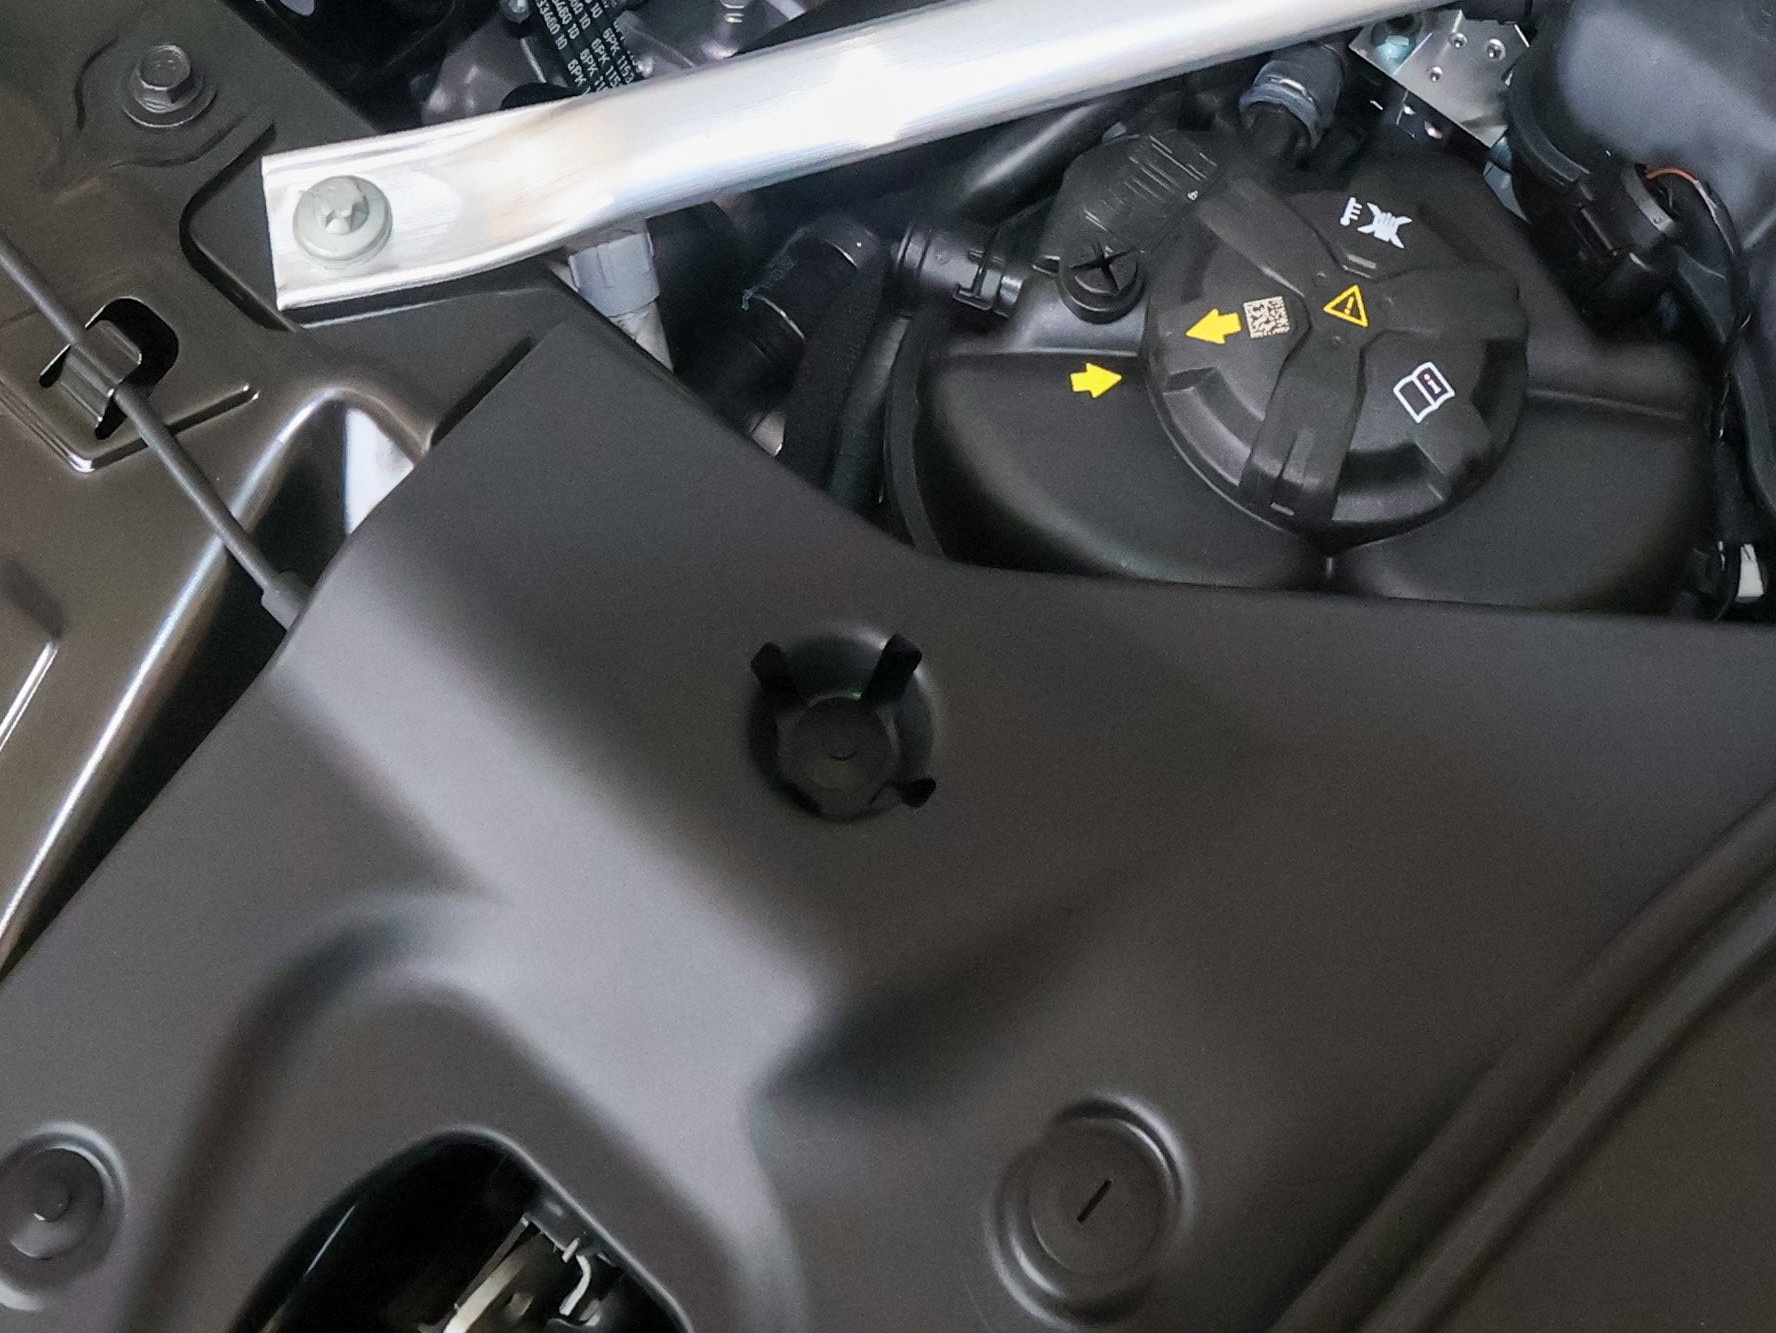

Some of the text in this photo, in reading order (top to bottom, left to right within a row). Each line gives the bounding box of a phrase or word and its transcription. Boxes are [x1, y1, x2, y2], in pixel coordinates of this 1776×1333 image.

[555, 34, 568, 51] 10
[567, 58, 587, 87] 6PK
[567, 23, 580, 40] 10
[579, 48, 600, 77] 6PK
[579, 13, 592, 30] 10
[591, 37, 611, 66] 6PK
[605, 66, 621, 89] 115
[602, 27, 620, 56] 6PK
